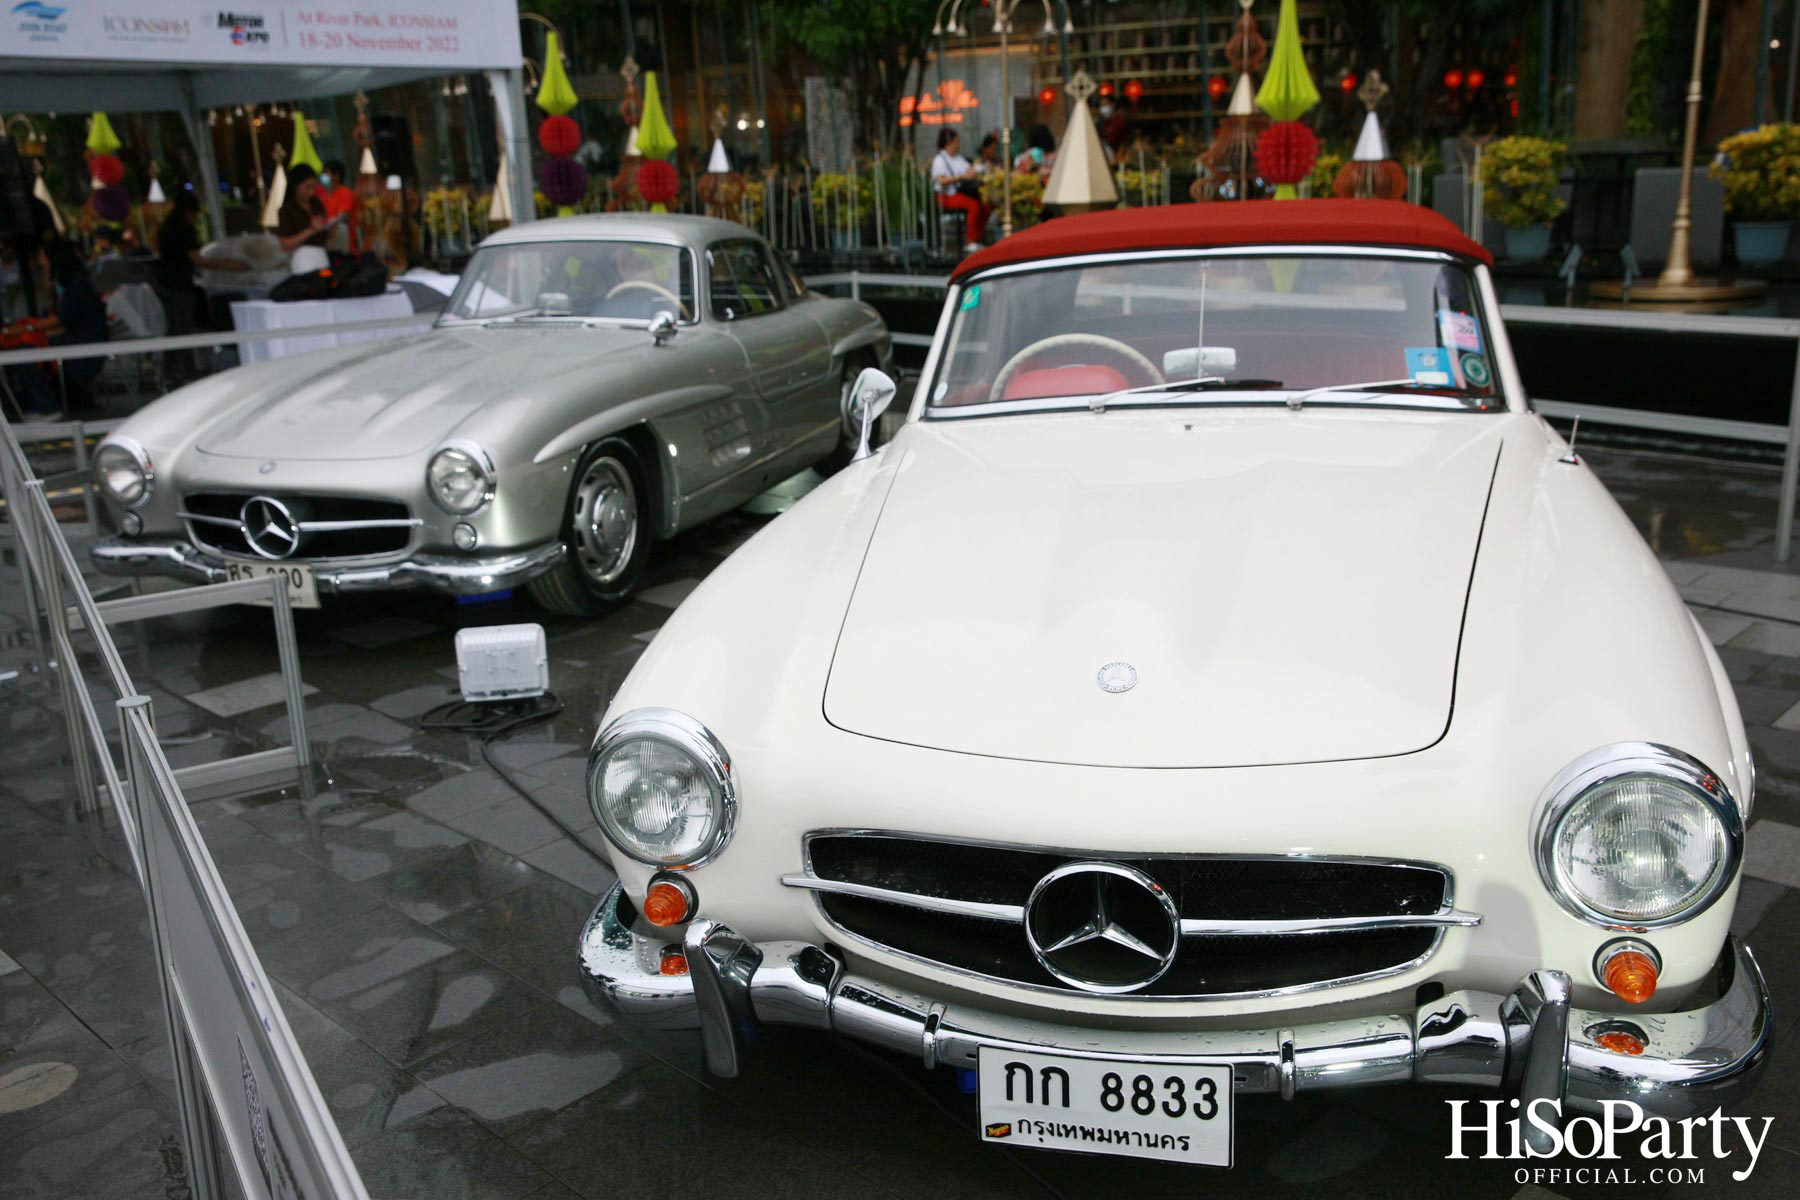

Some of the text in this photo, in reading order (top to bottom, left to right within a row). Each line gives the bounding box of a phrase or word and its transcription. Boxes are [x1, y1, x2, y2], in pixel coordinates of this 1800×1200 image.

[298, 10, 312, 24] At
[316, 10, 349, 26] River
[388, 13, 459, 30] ICONSIAM
[299, 31, 459, 53] 18-20 November 2022
[1004, 1061, 1219, 1121] กก 8833
[1017, 1118, 1191, 1151] กรุงเทพมหานคร
